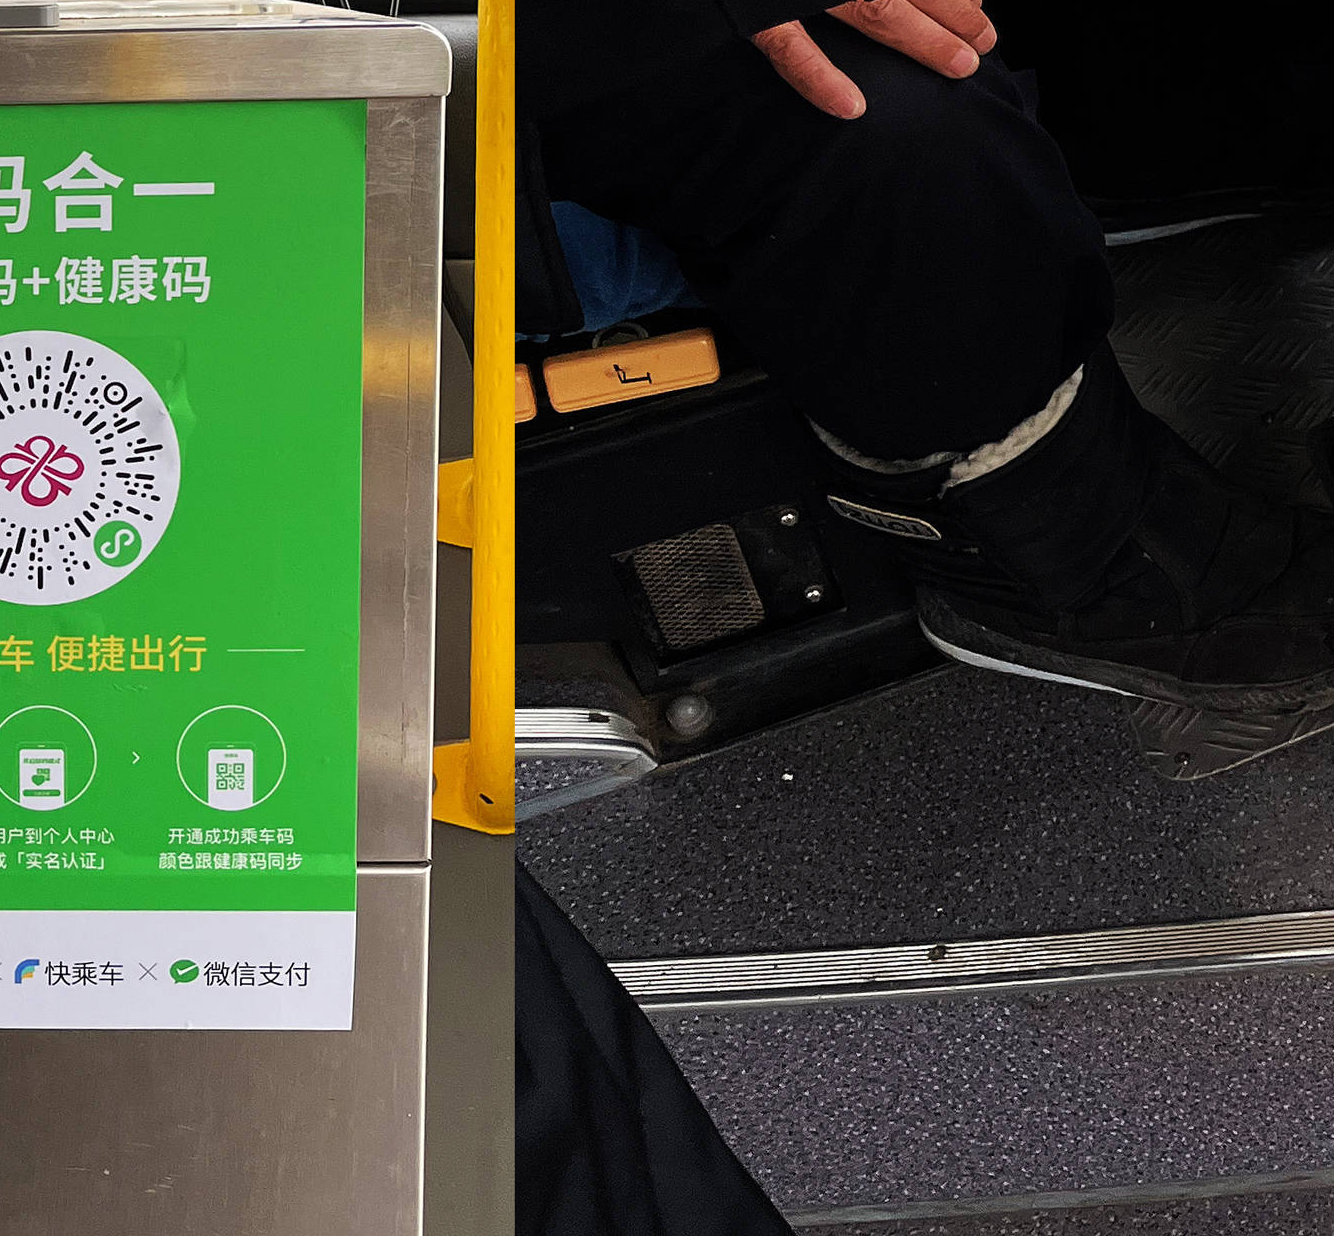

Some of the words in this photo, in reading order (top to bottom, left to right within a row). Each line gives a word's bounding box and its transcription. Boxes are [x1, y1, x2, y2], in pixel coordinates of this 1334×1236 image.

[47, 634, 208, 673] 便捷出行
[167, 826, 295, 847] 开通成功乘车码
[157, 851, 303, 872] 颜色跟健康码同步
[45, 961, 124, 986] 快乘车
[203, 961, 311, 987] 微信支付
